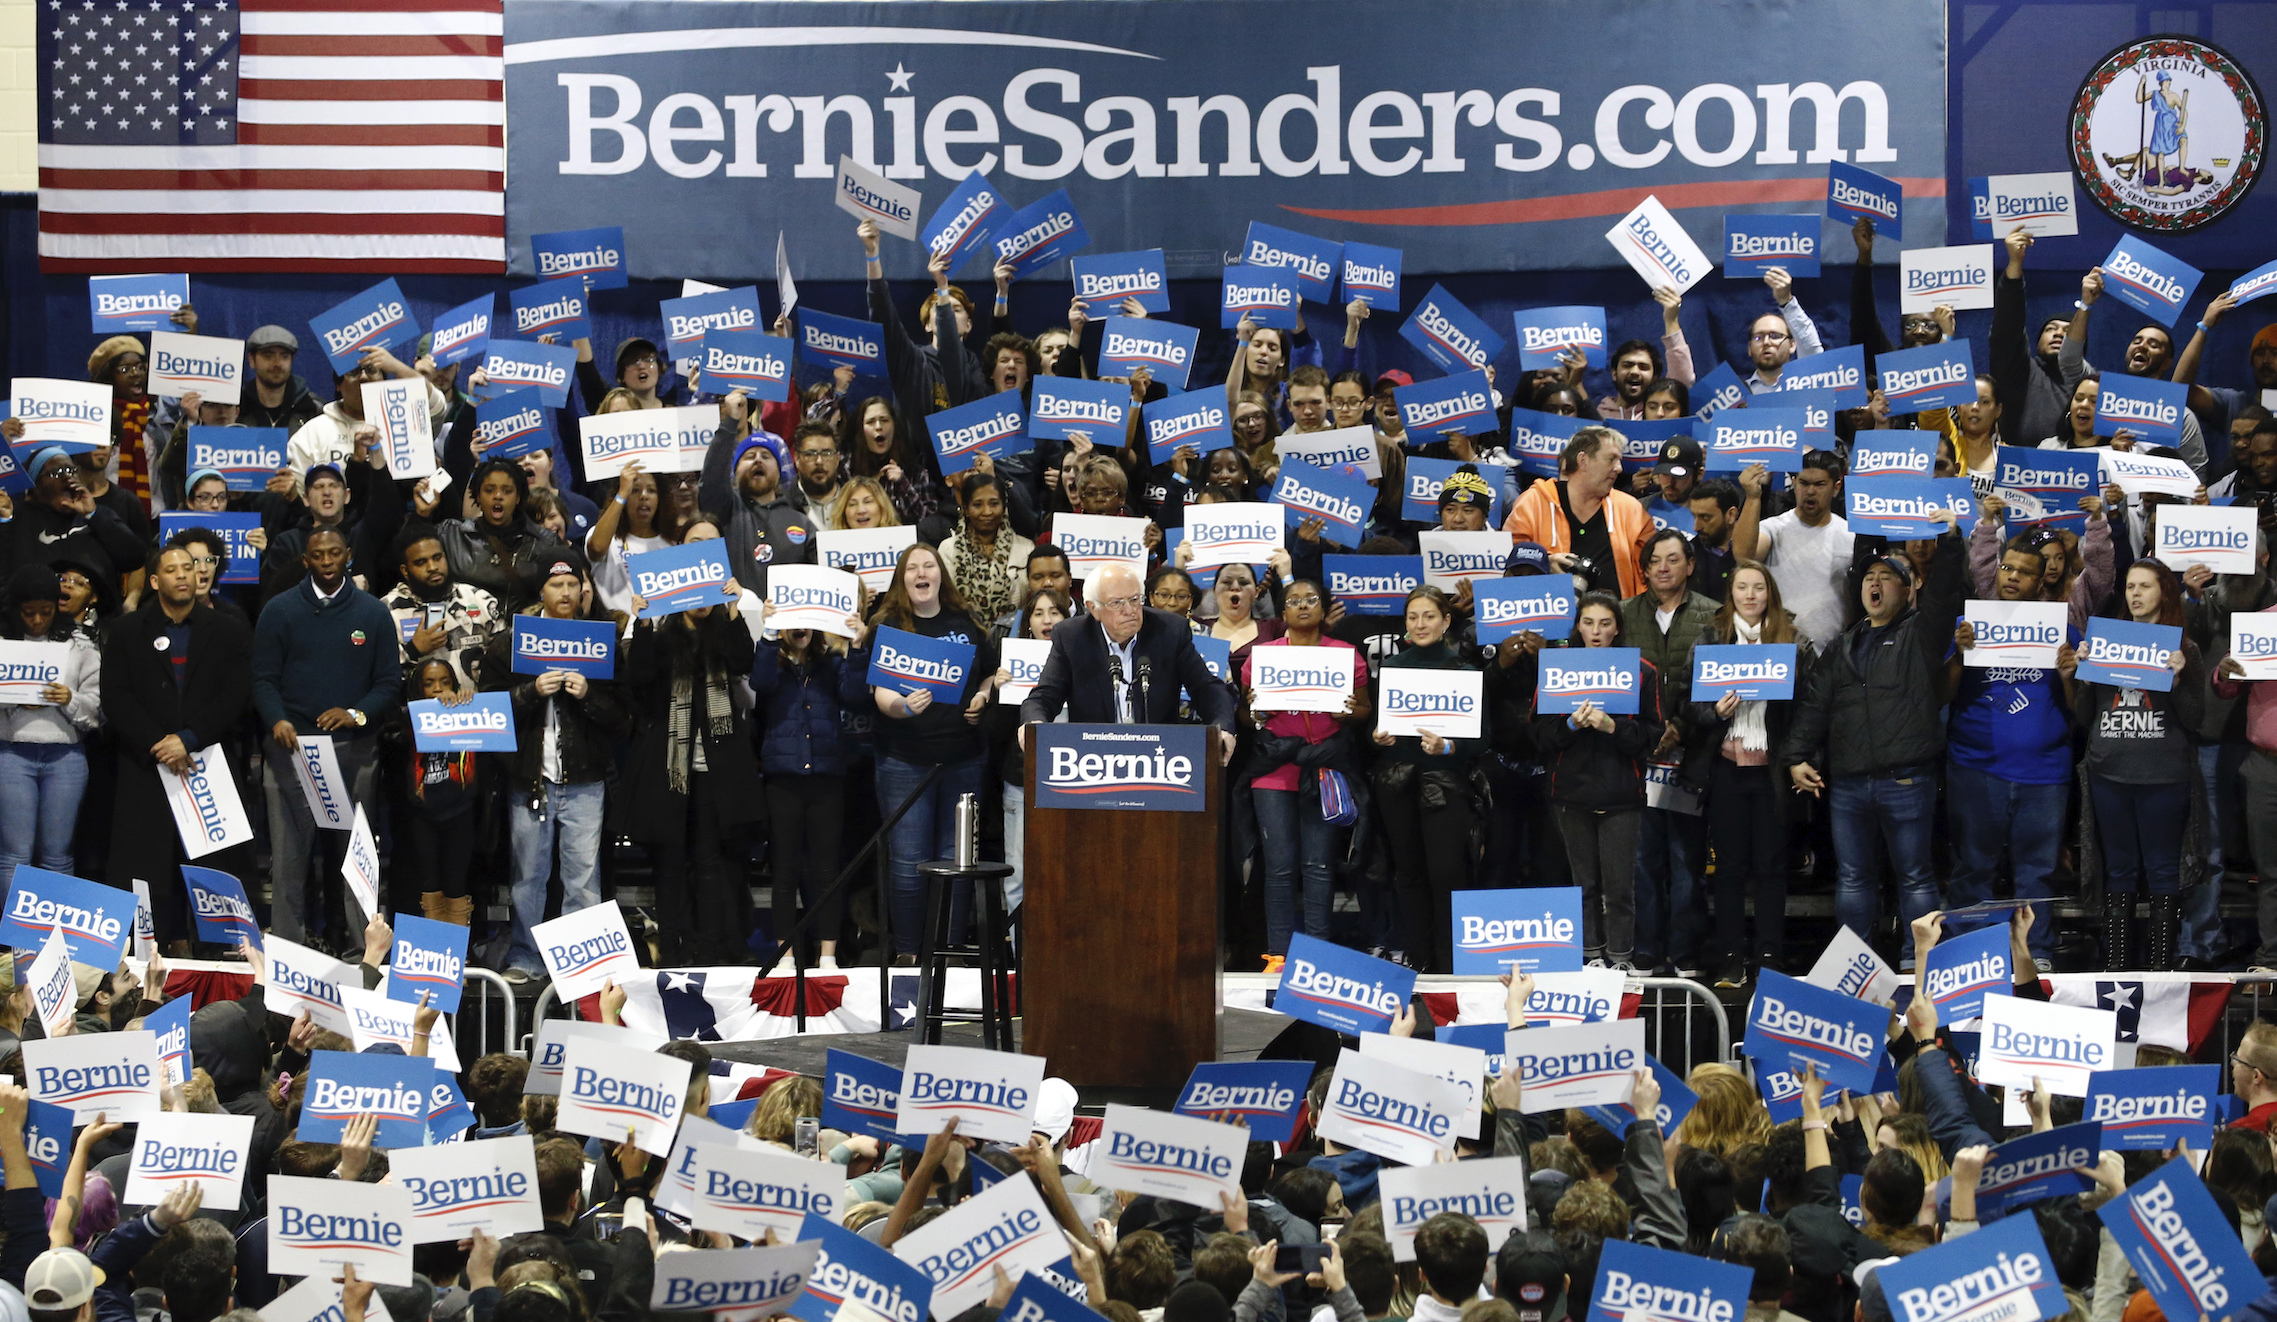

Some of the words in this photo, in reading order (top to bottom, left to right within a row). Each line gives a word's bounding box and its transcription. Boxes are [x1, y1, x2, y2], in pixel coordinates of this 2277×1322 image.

[2132, 58, 2207, 79] VIRGINIA
[557, 61, 1898, 182] BernieSanders.com
[842, 174, 911, 221] Bernie
[1833, 179, 1897, 219] Bernie
[1996, 191, 2068, 214] Bernie
[2110, 178, 2125, 194] SIC
[2125, 190, 2168, 210] SEMPER
[2170, 180, 2222, 210] TYRANNIS
[930, 190, 994, 254] Bernie
[998, 211, 1074, 256] Bernie
[540, 245, 619, 273] Bernie
[1630, 214, 1690, 284] Bernie
[1730, 232, 1814, 254] Bernie
[1249, 240, 1330, 281] Bernie
[1344, 259, 1395, 289] Bernie
[1908, 265, 1986, 289] Bernie
[1080, 268, 1160, 295] Bernie
[2109, 251, 2184, 304] Bernie
[2230, 271, 2277, 299] Bern
[97, 289, 182, 312] Bernie
[516, 295, 582, 325] Bernie
[1226, 282, 1291, 307] Bernie
[323, 302, 404, 352] Bernie
[434, 312, 488, 347] Bernie
[670, 304, 754, 336] Bernie
[1418, 302, 1487, 366] Bernie
[1523, 322, 1602, 349] Bernie
[804, 323, 878, 358] Bernie
[1108, 334, 1186, 364] Bernie
[156, 352, 235, 379] Bernie
[486, 354, 565, 384] Bernie
[707, 347, 785, 378] Bernie
[1883, 360, 1966, 393] Bernie
[18, 398, 104, 422] Bernie
[479, 404, 542, 442] Bernie
[1038, 393, 1121, 423] Bernie
[1404, 391, 1486, 426] Bernie
[2100, 392, 2177, 423] Bernie
[388, 387, 411, 470] Bernie
[937, 413, 1021, 453] Bernie
[1150, 407, 1223, 443] Bernie
[1516, 427, 1567, 451] Bern
[1715, 424, 1797, 449] Bernie
[194, 443, 281, 469] Bernie
[589, 428, 671, 456] Bernie
[1855, 446, 1929, 471] Bernie
[2003, 466, 2089, 490] Bernie
[2115, 459, 2190, 480] Bernie
[1279, 476, 1362, 523] Bernie
[1412, 475, 1497, 501] Bee
[1852, 492, 1940, 516] Bernie
[1060, 533, 1142, 558] Bernie
[1192, 521, 1276, 543] Bernie
[2163, 526, 2248, 550] Bernie
[238, 544, 256, 559] IN
[1429, 551, 1506, 571] Bernie
[637, 560, 724, 595] Bernie
[1330, 572, 1418, 594] Bernie
[774, 585, 852, 611] Bernie
[1482, 593, 1569, 621] Bernie
[520, 633, 608, 658] Bernie
[1973, 620, 2059, 644] Bernie
[877, 645, 962, 682] Bernie
[2089, 637, 2170, 665] Bernie
[0, 660, 59, 682] ernie
[1259, 665, 1345, 689] Bernie
[1546, 663, 1633, 690] Bernie
[1700, 658, 1787, 681] Bernie
[1388, 688, 1473, 712] Bernie
[418, 707, 507, 732] Bernie
[2101, 711, 2165, 731] BERNIE
[2124, 730, 2136, 738] THE
[2138, 730, 2165, 739] MACHINE
[1082, 732, 1159, 742] BernieSanders.com
[1049, 745, 1193, 784] Bernie
[189, 757, 226, 842] Bernie
[304, 744, 339, 823] Bernie
[13, 890, 120, 942] Bernie
[192, 888, 254, 923] Bernie
[1461, 910, 1574, 946] Bernie
[396, 940, 460, 982] Bernie
[548, 928, 627, 969] Bernie
[37, 954, 69, 1014] Bernie
[272, 959, 345, 1008] Berni
[1289, 959, 1400, 1013] Bernie
[1926, 951, 2005, 996] Bernie
[356, 1009, 442, 1047] Berne
[1757, 996, 1873, 1058] Bernie
[1990, 1023, 2103, 1065] Bernie
[36, 1056, 150, 1095] Bernie
[1517, 1043, 1635, 1081] Bernie
[311, 1078, 421, 1117] Bernie
[571, 1065, 676, 1119] Bernie
[910, 1072, 1027, 1110] Bernie
[1187, 1081, 1294, 1111] Bernie
[1340, 1078, 1449, 1136] Bernie
[2092, 1087, 2206, 1121] Bernie
[140, 1140, 237, 1173] Bernie
[1108, 1130, 1231, 1178] Bernie
[403, 1166, 527, 1209] Bernie
[706, 1170, 831, 1214] Bernie
[279, 1206, 402, 1247] Bernie
[918, 1208, 1040, 1282] Bernie
[2136, 1180, 2229, 1311] Bernie
[664, 1272, 800, 1305] Bernie
[808, 1249, 918, 1322] Bernie
[1601, 1270, 1734, 1322] Bernie
[1897, 1251, 2042, 1322] Bernie
